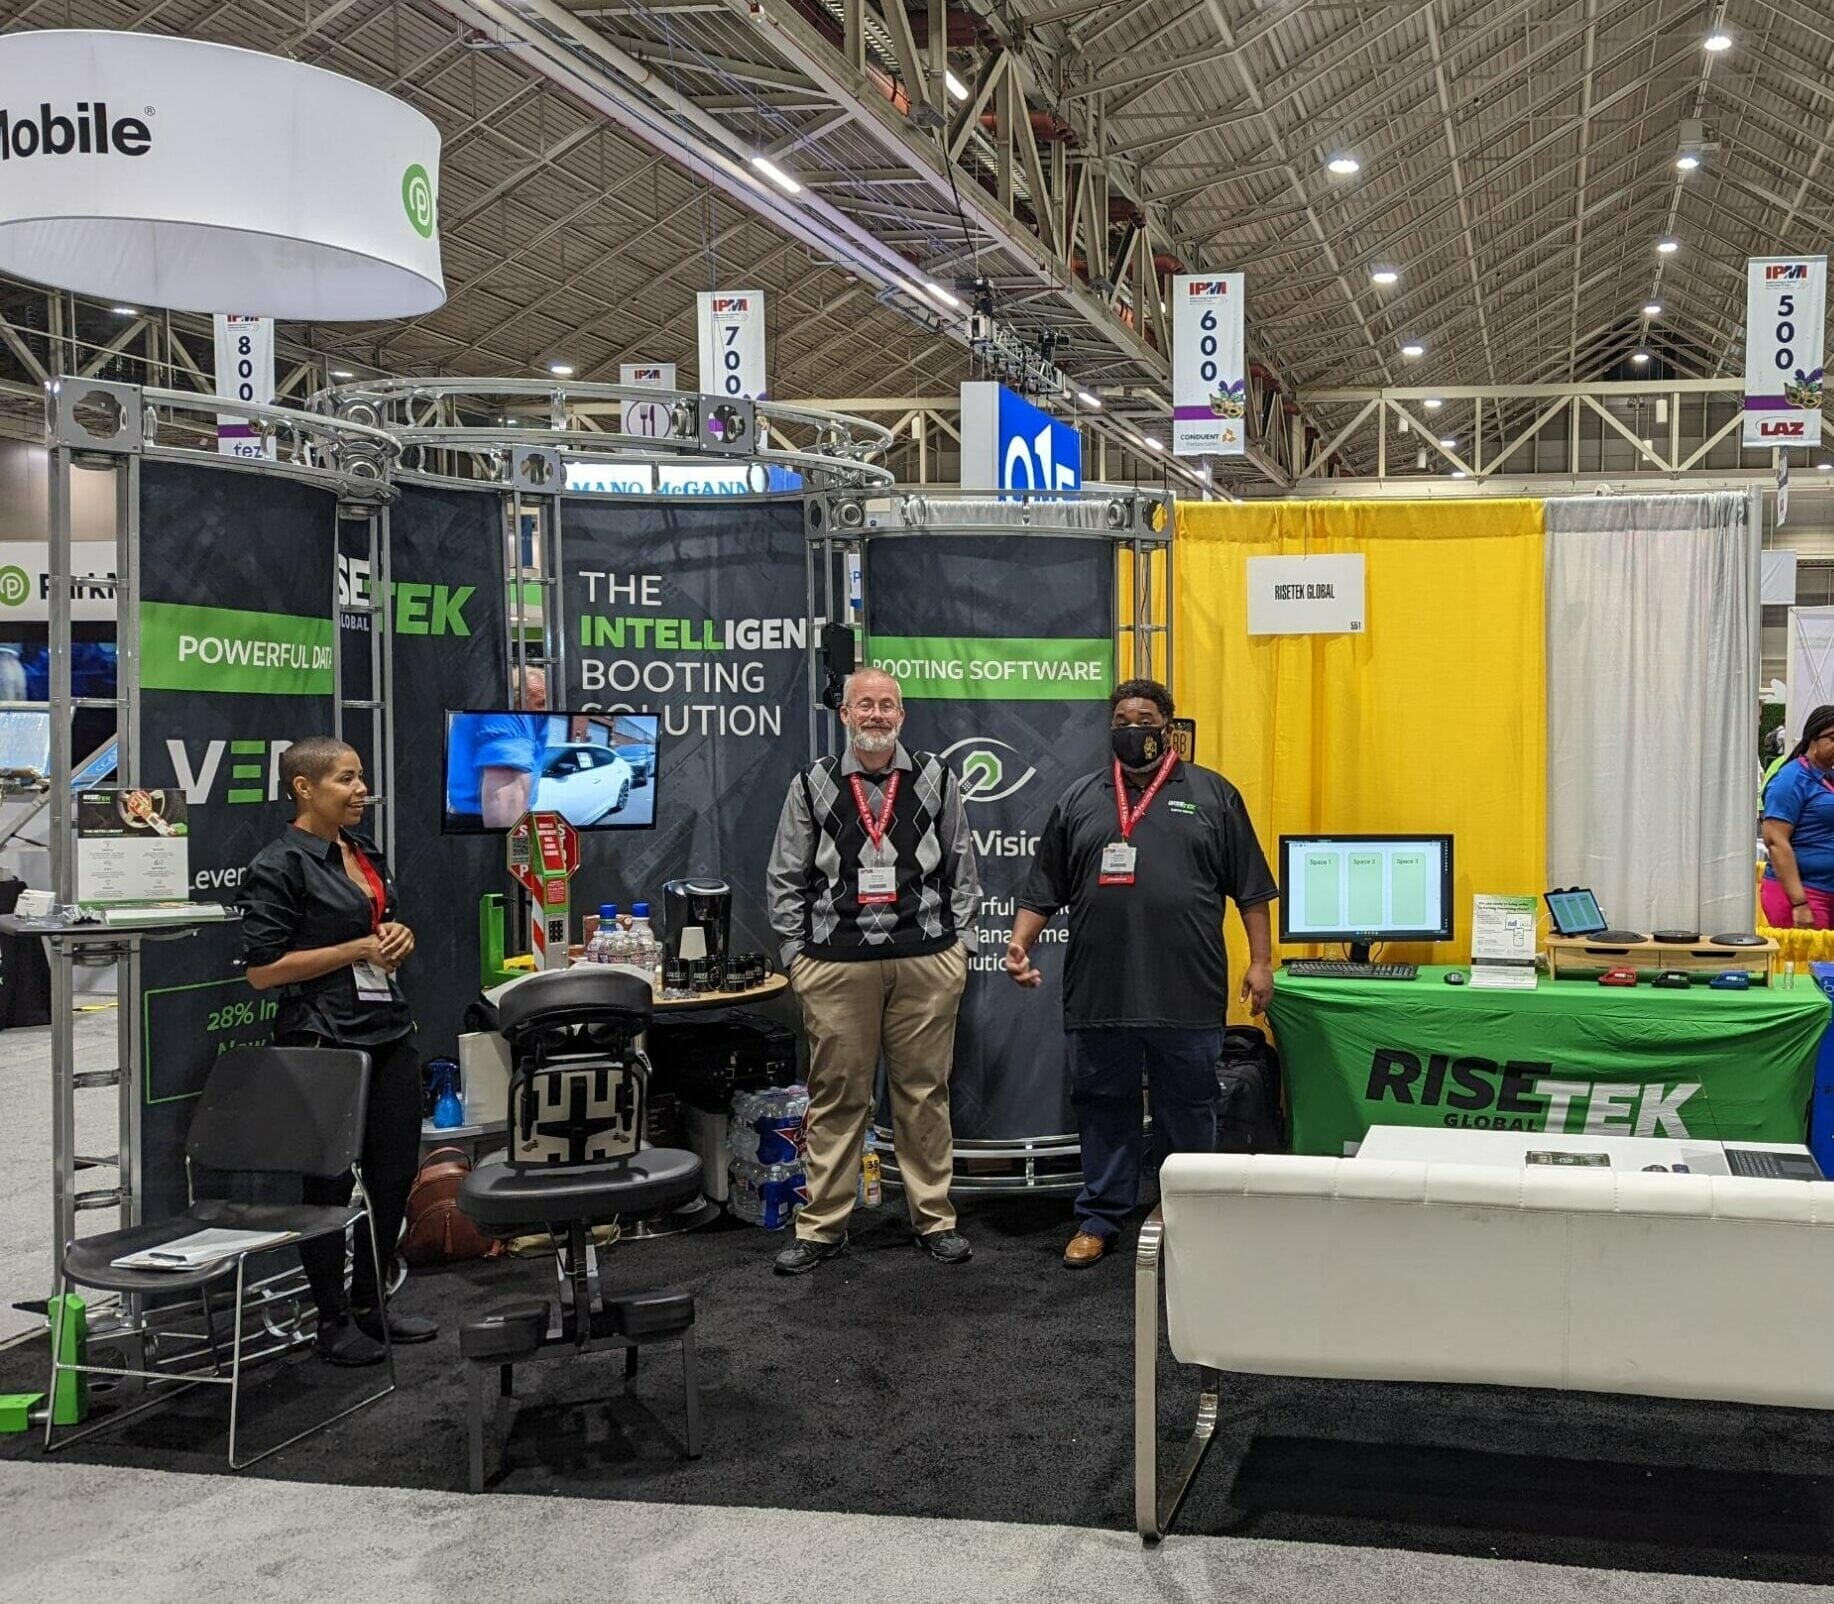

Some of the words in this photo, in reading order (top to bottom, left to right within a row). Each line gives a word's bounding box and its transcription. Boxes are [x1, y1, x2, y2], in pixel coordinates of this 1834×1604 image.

[1200, 310, 1217, 382] 600
[1775, 295, 1795, 370] 500
[238, 335, 253, 401] 800
[724, 326, 741, 395] 700
[1180, 433, 1220, 441] CONDUENT
[1760, 421, 1804, 436] LAZ
[579, 571, 662, 606] THE
[1274, 584, 1305, 600] RISETEK
[1306, 583, 1336, 599] GLOBAL
[340, 613, 370, 632] LOBAL
[580, 614, 827, 650] INTELLIGENT
[178, 635, 309, 669] POWERFUL
[582, 659, 765, 693] BOOTING
[969, 660, 1102, 680] SOFTWARE
[580, 702, 782, 736] UTION
[189, 866, 246, 890] ever
[981, 896, 1015, 916] rful
[207, 1001, 254, 1031] 28%
[259, 999, 278, 1021] In
[1365, 1048, 1702, 1138] RISETEK
[1443, 1112, 1539, 1132] GLOBAL
